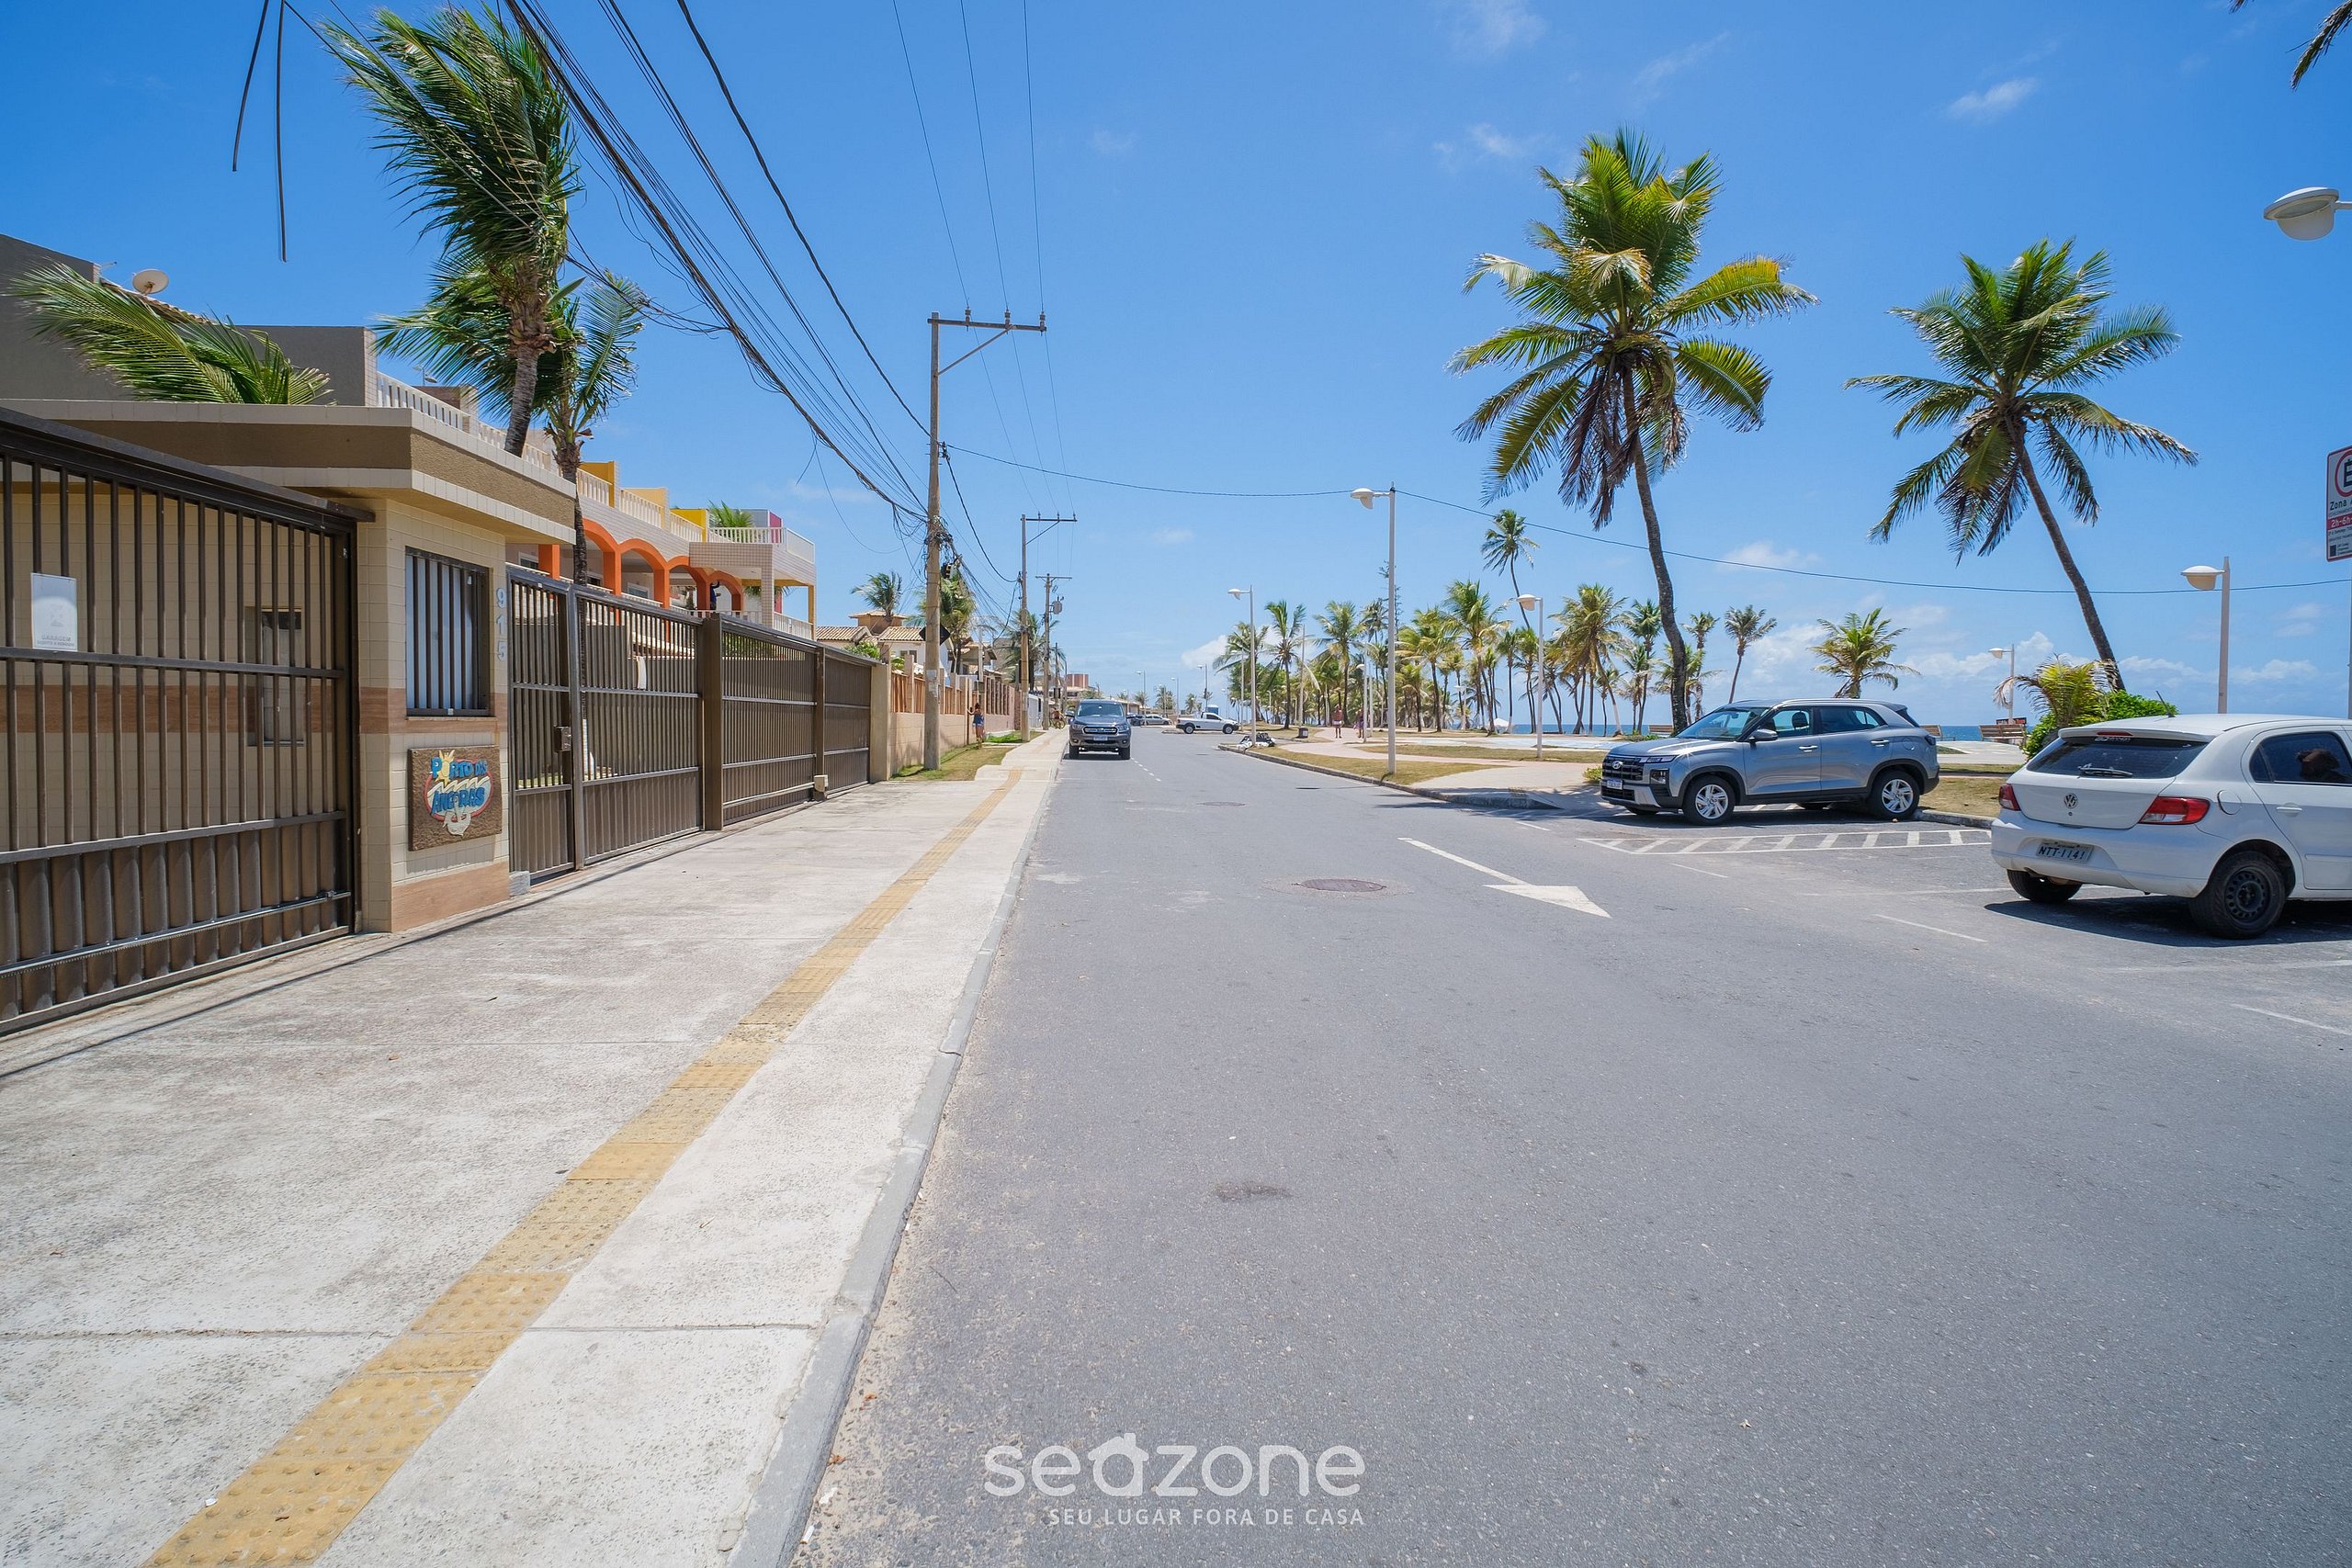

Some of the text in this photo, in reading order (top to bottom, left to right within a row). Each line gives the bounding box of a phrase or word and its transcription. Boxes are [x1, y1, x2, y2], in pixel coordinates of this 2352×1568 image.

[2330, 500, 2346, 510] Zona
[496, 588, 507, 661] 915
[431, 757, 488, 779] PORTO DAS
